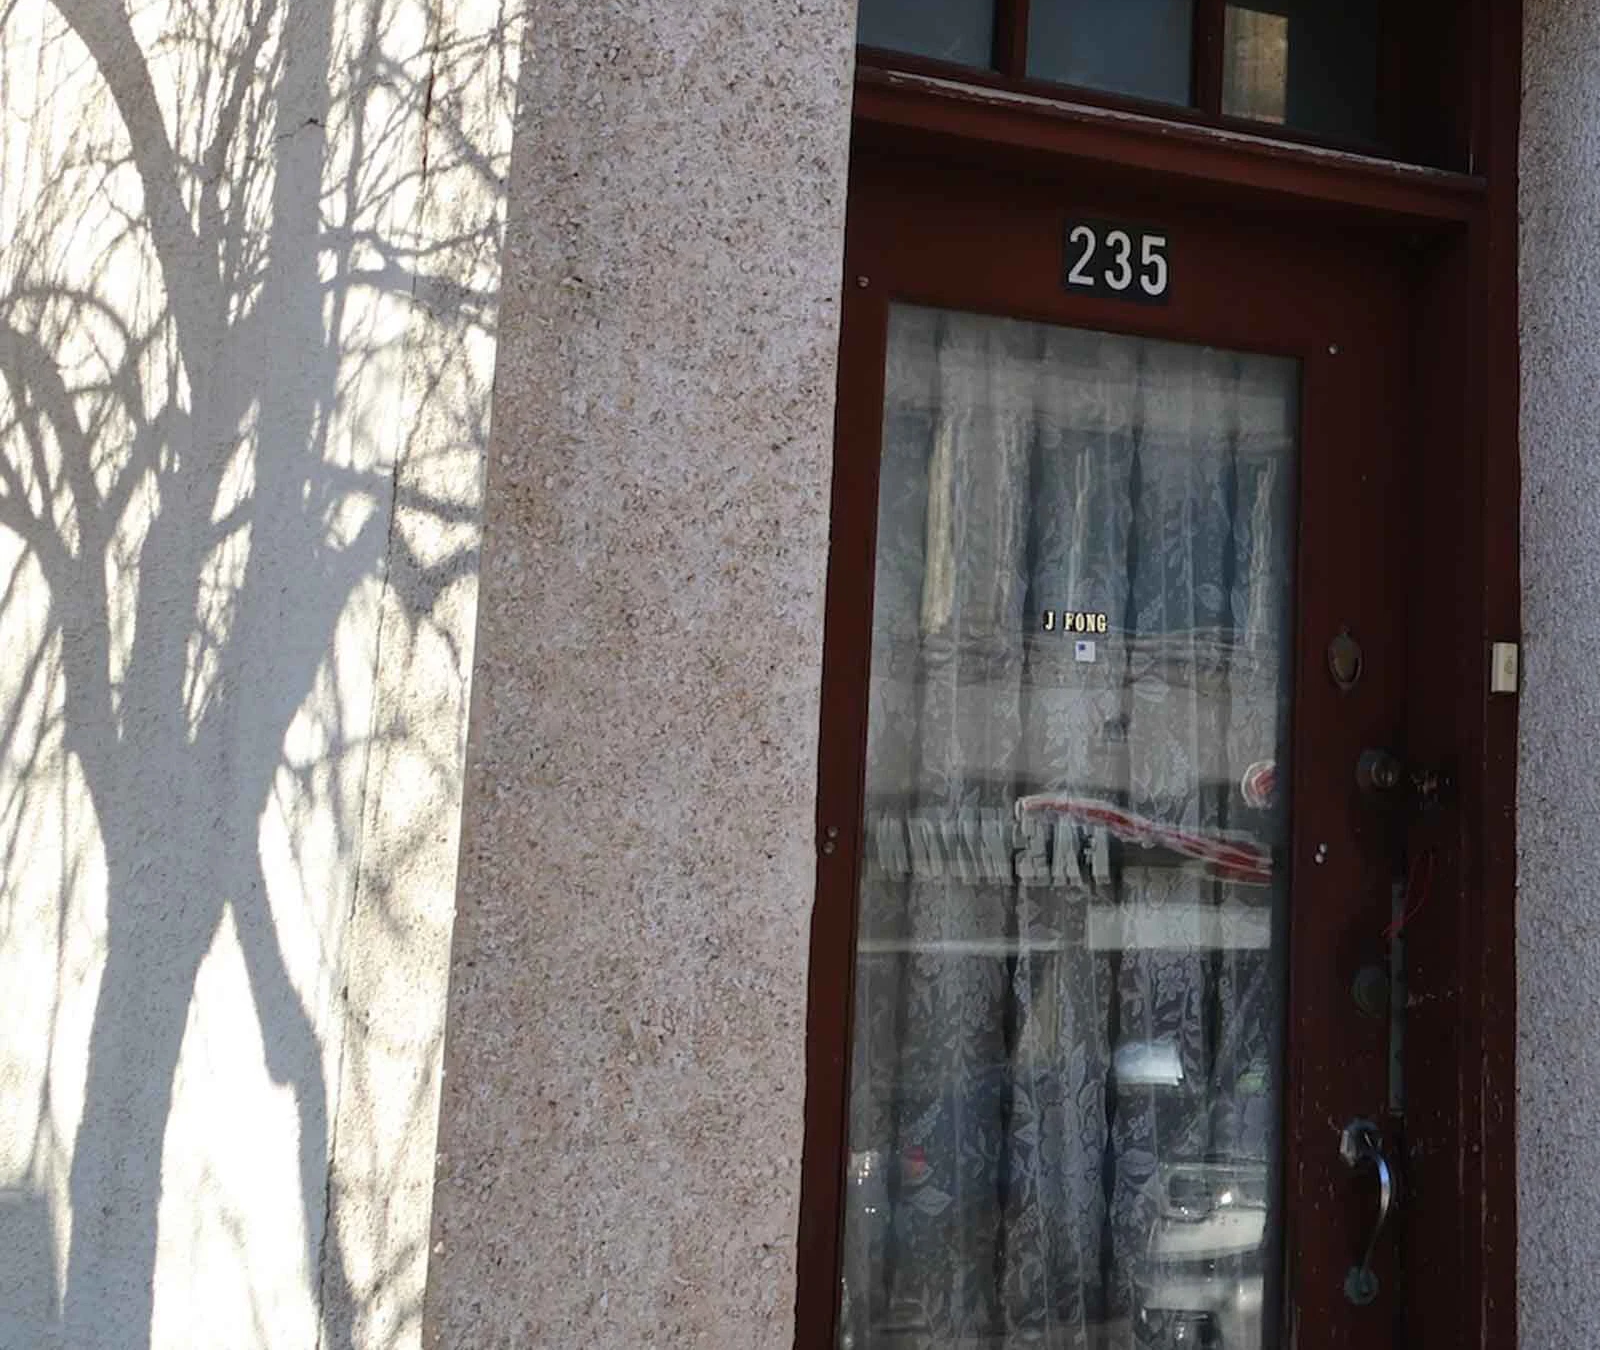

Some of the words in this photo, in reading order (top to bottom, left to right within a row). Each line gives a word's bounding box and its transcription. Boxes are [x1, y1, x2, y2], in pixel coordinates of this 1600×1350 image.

[1068, 225, 1168, 296] 235
[1043, 610, 1055, 631] J
[1063, 611, 1107, 633] FONG
